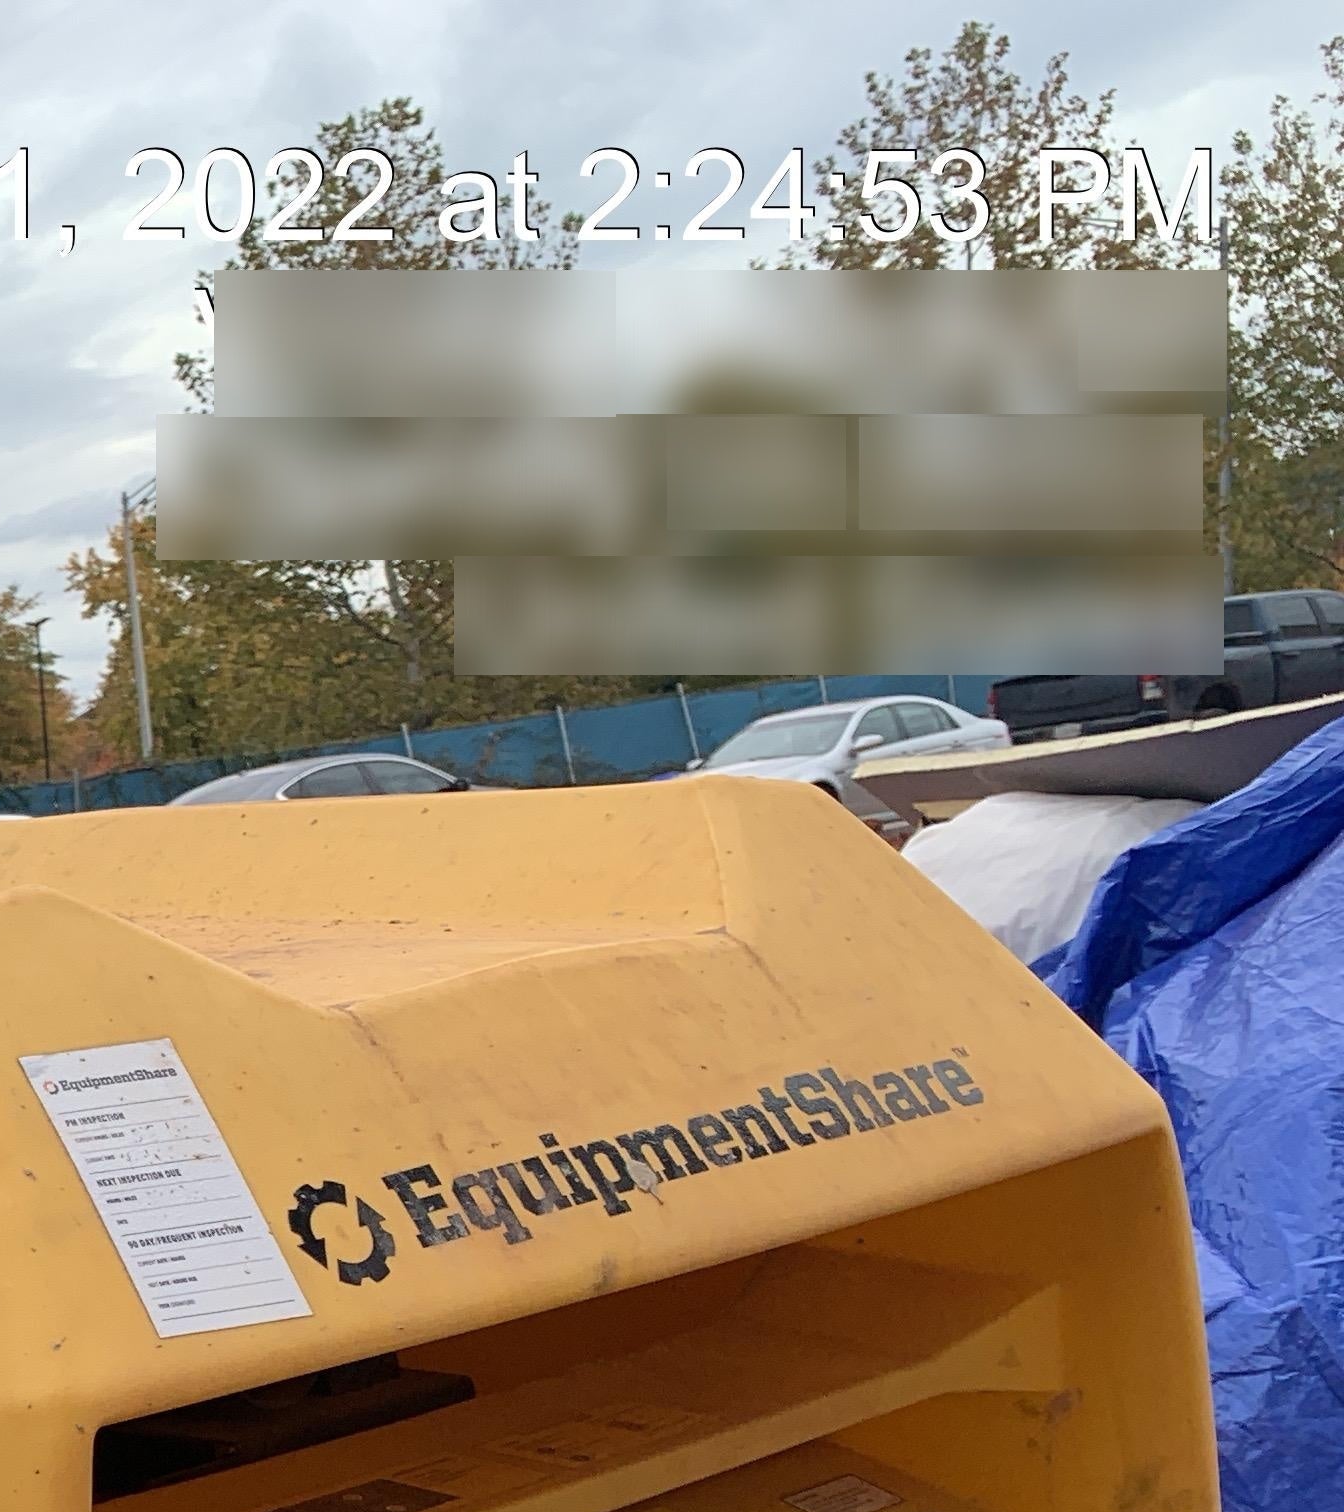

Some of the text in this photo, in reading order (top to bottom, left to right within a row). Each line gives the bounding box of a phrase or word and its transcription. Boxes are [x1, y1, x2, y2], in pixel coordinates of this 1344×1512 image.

[58, 1066, 178, 1094] EquipmentShare
[64, 1112, 126, 1128] PM INSPECTION
[382, 1054, 984, 1248] EquipmentShare
[96, 1168, 182, 1188] NEXT INSPECTION DUE
[199, 1225, 244, 1240] INSPECTION
